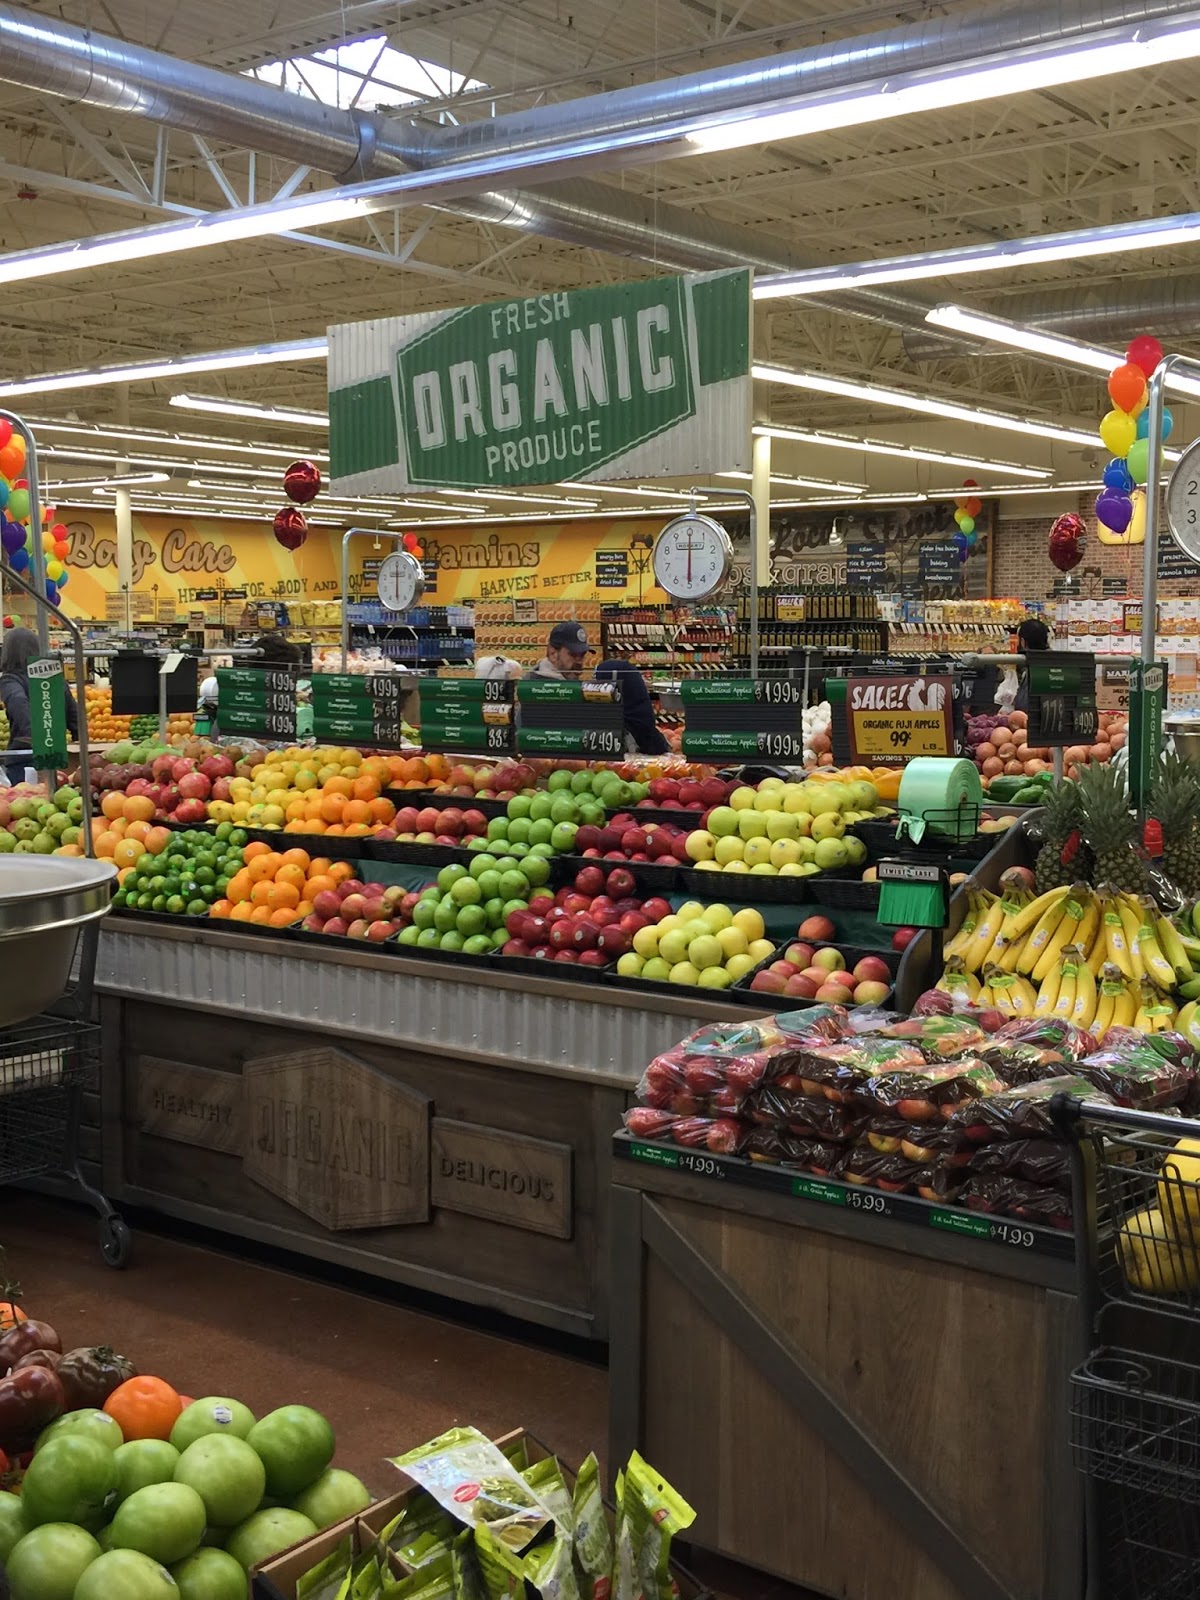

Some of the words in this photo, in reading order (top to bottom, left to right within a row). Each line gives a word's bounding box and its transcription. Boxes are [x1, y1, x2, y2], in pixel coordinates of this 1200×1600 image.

[491, 292, 570, 338] FRESH
[412, 304, 675, 451] ORGANIC
[486, 420, 601, 477] PRODUCE
[1188, 481, 1197, 495] 2
[1187, 509, 1196, 523] 3
[673, 533, 679, 541] 9
[161, 529, 237, 573] Care
[664, 546, 670, 555] 8
[710, 545, 716, 554] 2
[665, 563, 670, 571] 7
[710, 562, 716, 571] 3
[673, 576, 679, 584] 6
[700, 575, 706, 583] 4
[1158, 569, 1181, 578] granola
[278, 578, 308, 595] BODY
[313, 581, 338, 591] AND
[480, 575, 538, 596] HARVEST
[543, 571, 592, 587] BETTER
[687, 581, 692, 589] 5
[29, 663, 60, 675] ORGANIC
[733, 687, 752, 697] Apples
[851, 682, 910, 710] SALE!
[41, 681, 54, 747] ORGANIC
[863, 720, 894, 729] ORGANIC
[896, 720, 912, 729] FUJI
[914, 719, 940, 729] APPLES
[255, 1095, 414, 1185] ORGANIC
[439, 1156, 555, 1203] DELICIOUS
